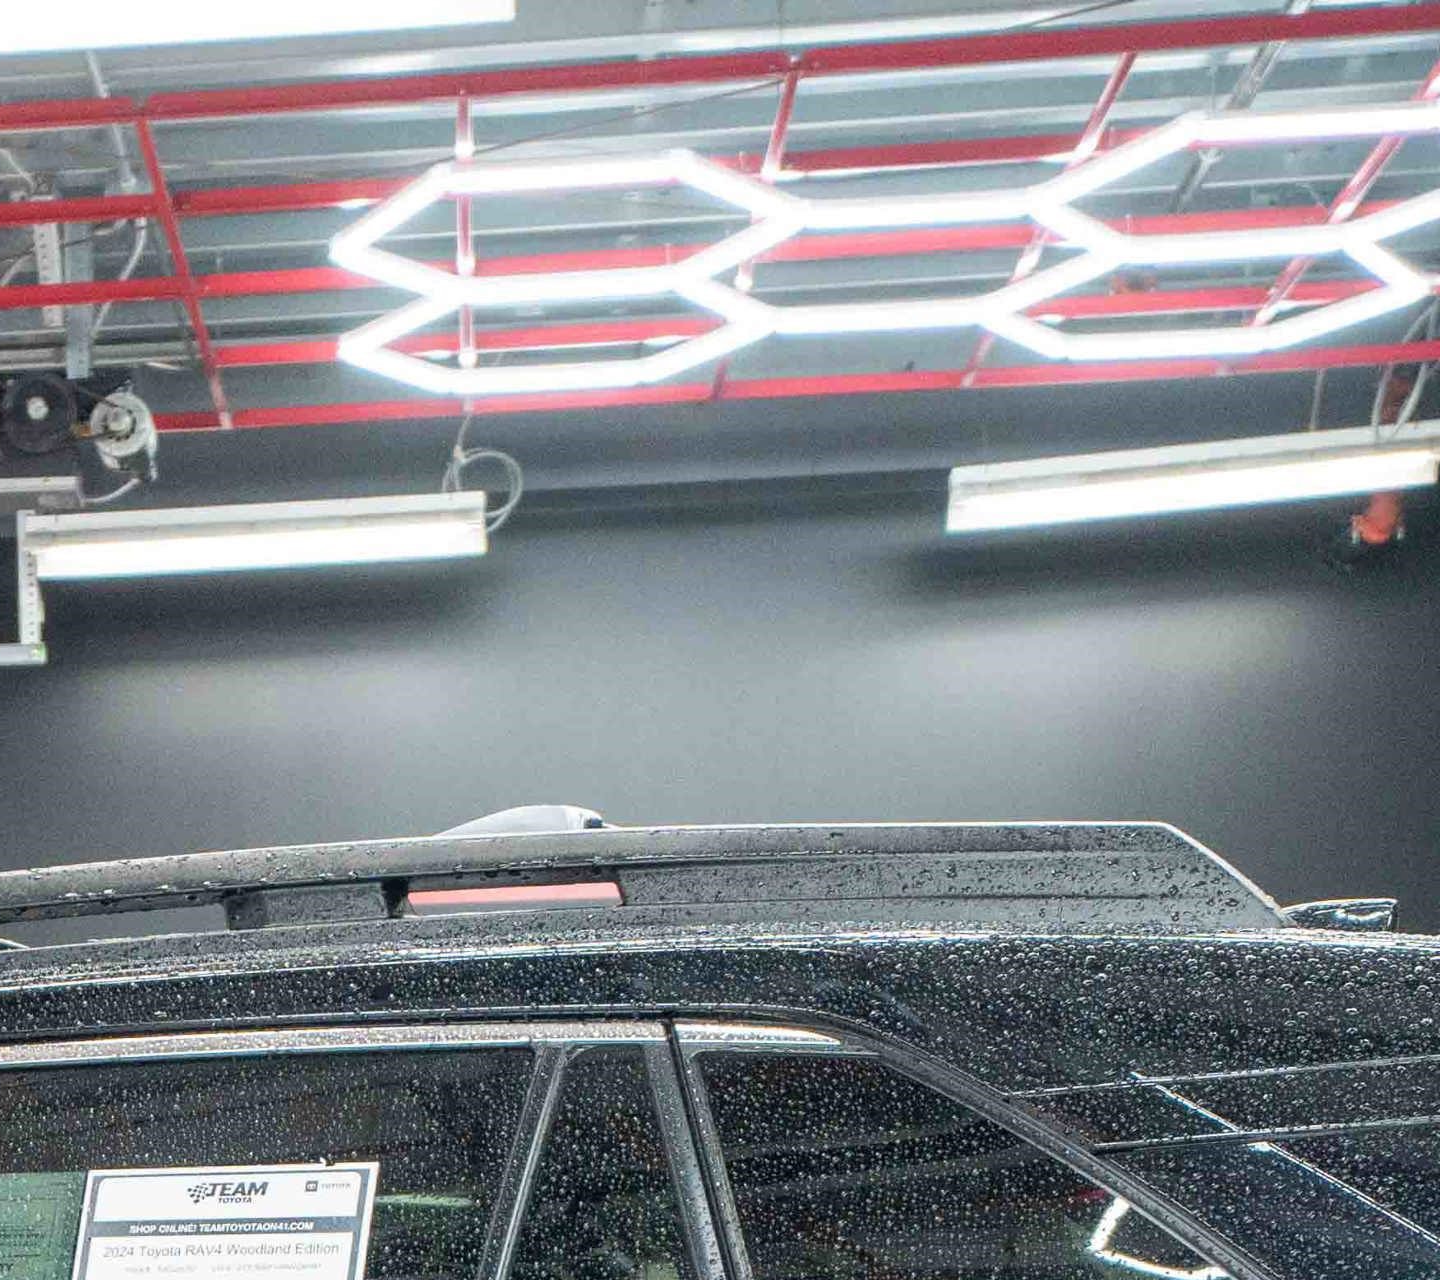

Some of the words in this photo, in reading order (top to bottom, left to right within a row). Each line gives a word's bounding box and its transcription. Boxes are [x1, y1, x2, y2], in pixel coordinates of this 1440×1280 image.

[206, 1181, 268, 1197] TEAM
[218, 1196, 253, 1204] TOYOTA
[129, 1224, 156, 1234] SHOP
[158, 1223, 197, 1234] ONLINE!
[103, 1246, 135, 1258] 2024
[140, 1245, 181, 1259] Toyota
[185, 1243, 222, 1257] RAV4
[226, 1242, 292, 1256] Woodland
[294, 1240, 340, 1255] Edition
